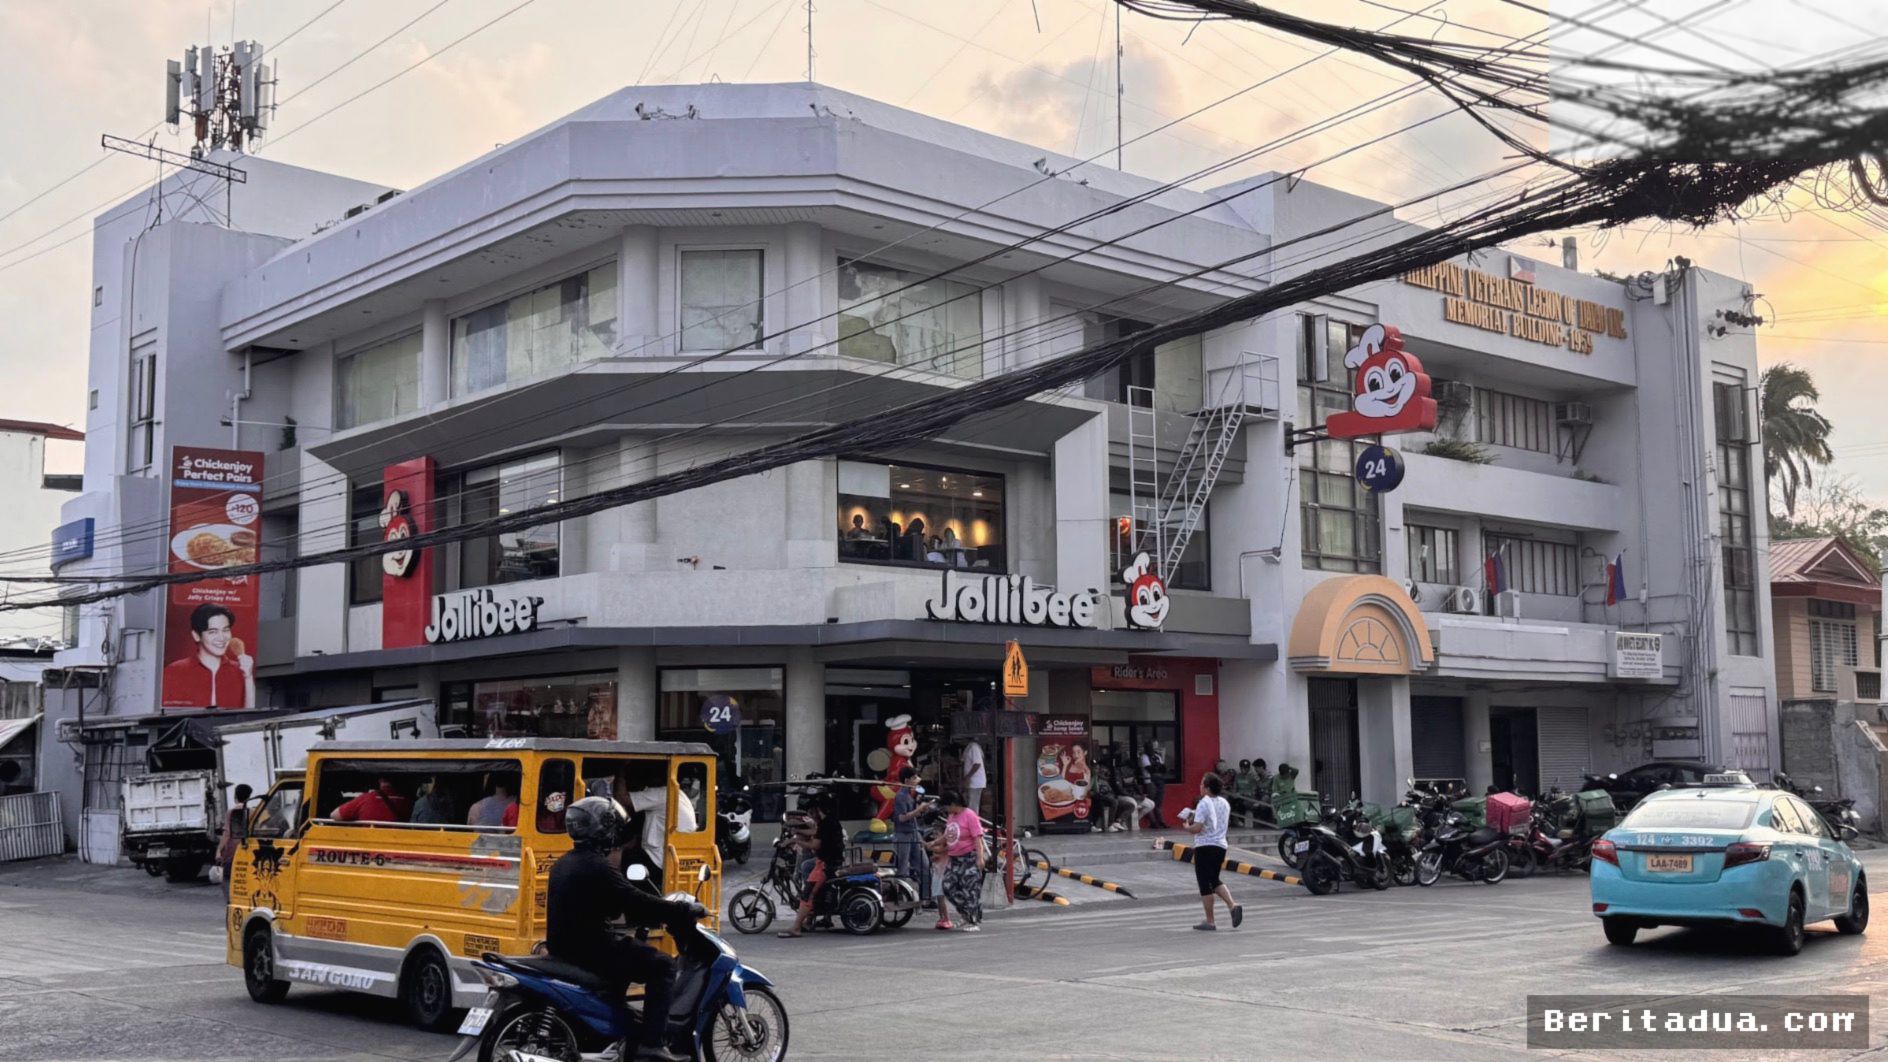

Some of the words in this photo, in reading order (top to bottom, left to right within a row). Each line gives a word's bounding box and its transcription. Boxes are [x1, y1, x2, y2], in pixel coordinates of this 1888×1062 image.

[1468, 269, 1524, 311] VETERANS
[1526, 284, 1560, 321] LEGION
[1563, 295, 1576, 325] OF
[1445, 298, 1507, 333] MEMORIAL
[194, 458, 253, 474] Chickenjoy
[1365, 458, 1387, 479] 24
[183, 469, 224, 481] Perfect
[226, 472, 252, 483] Pairs
[929, 569, 1095, 627] Jollibee
[425, 588, 536, 643] Jollibee
[1114, 666, 1143, 679] Rider's
[1146, 668, 1168, 679] Area
[709, 705, 732, 723] 24
[1637, 833, 1655, 845] 124
[1681, 835, 1714, 846] 3392
